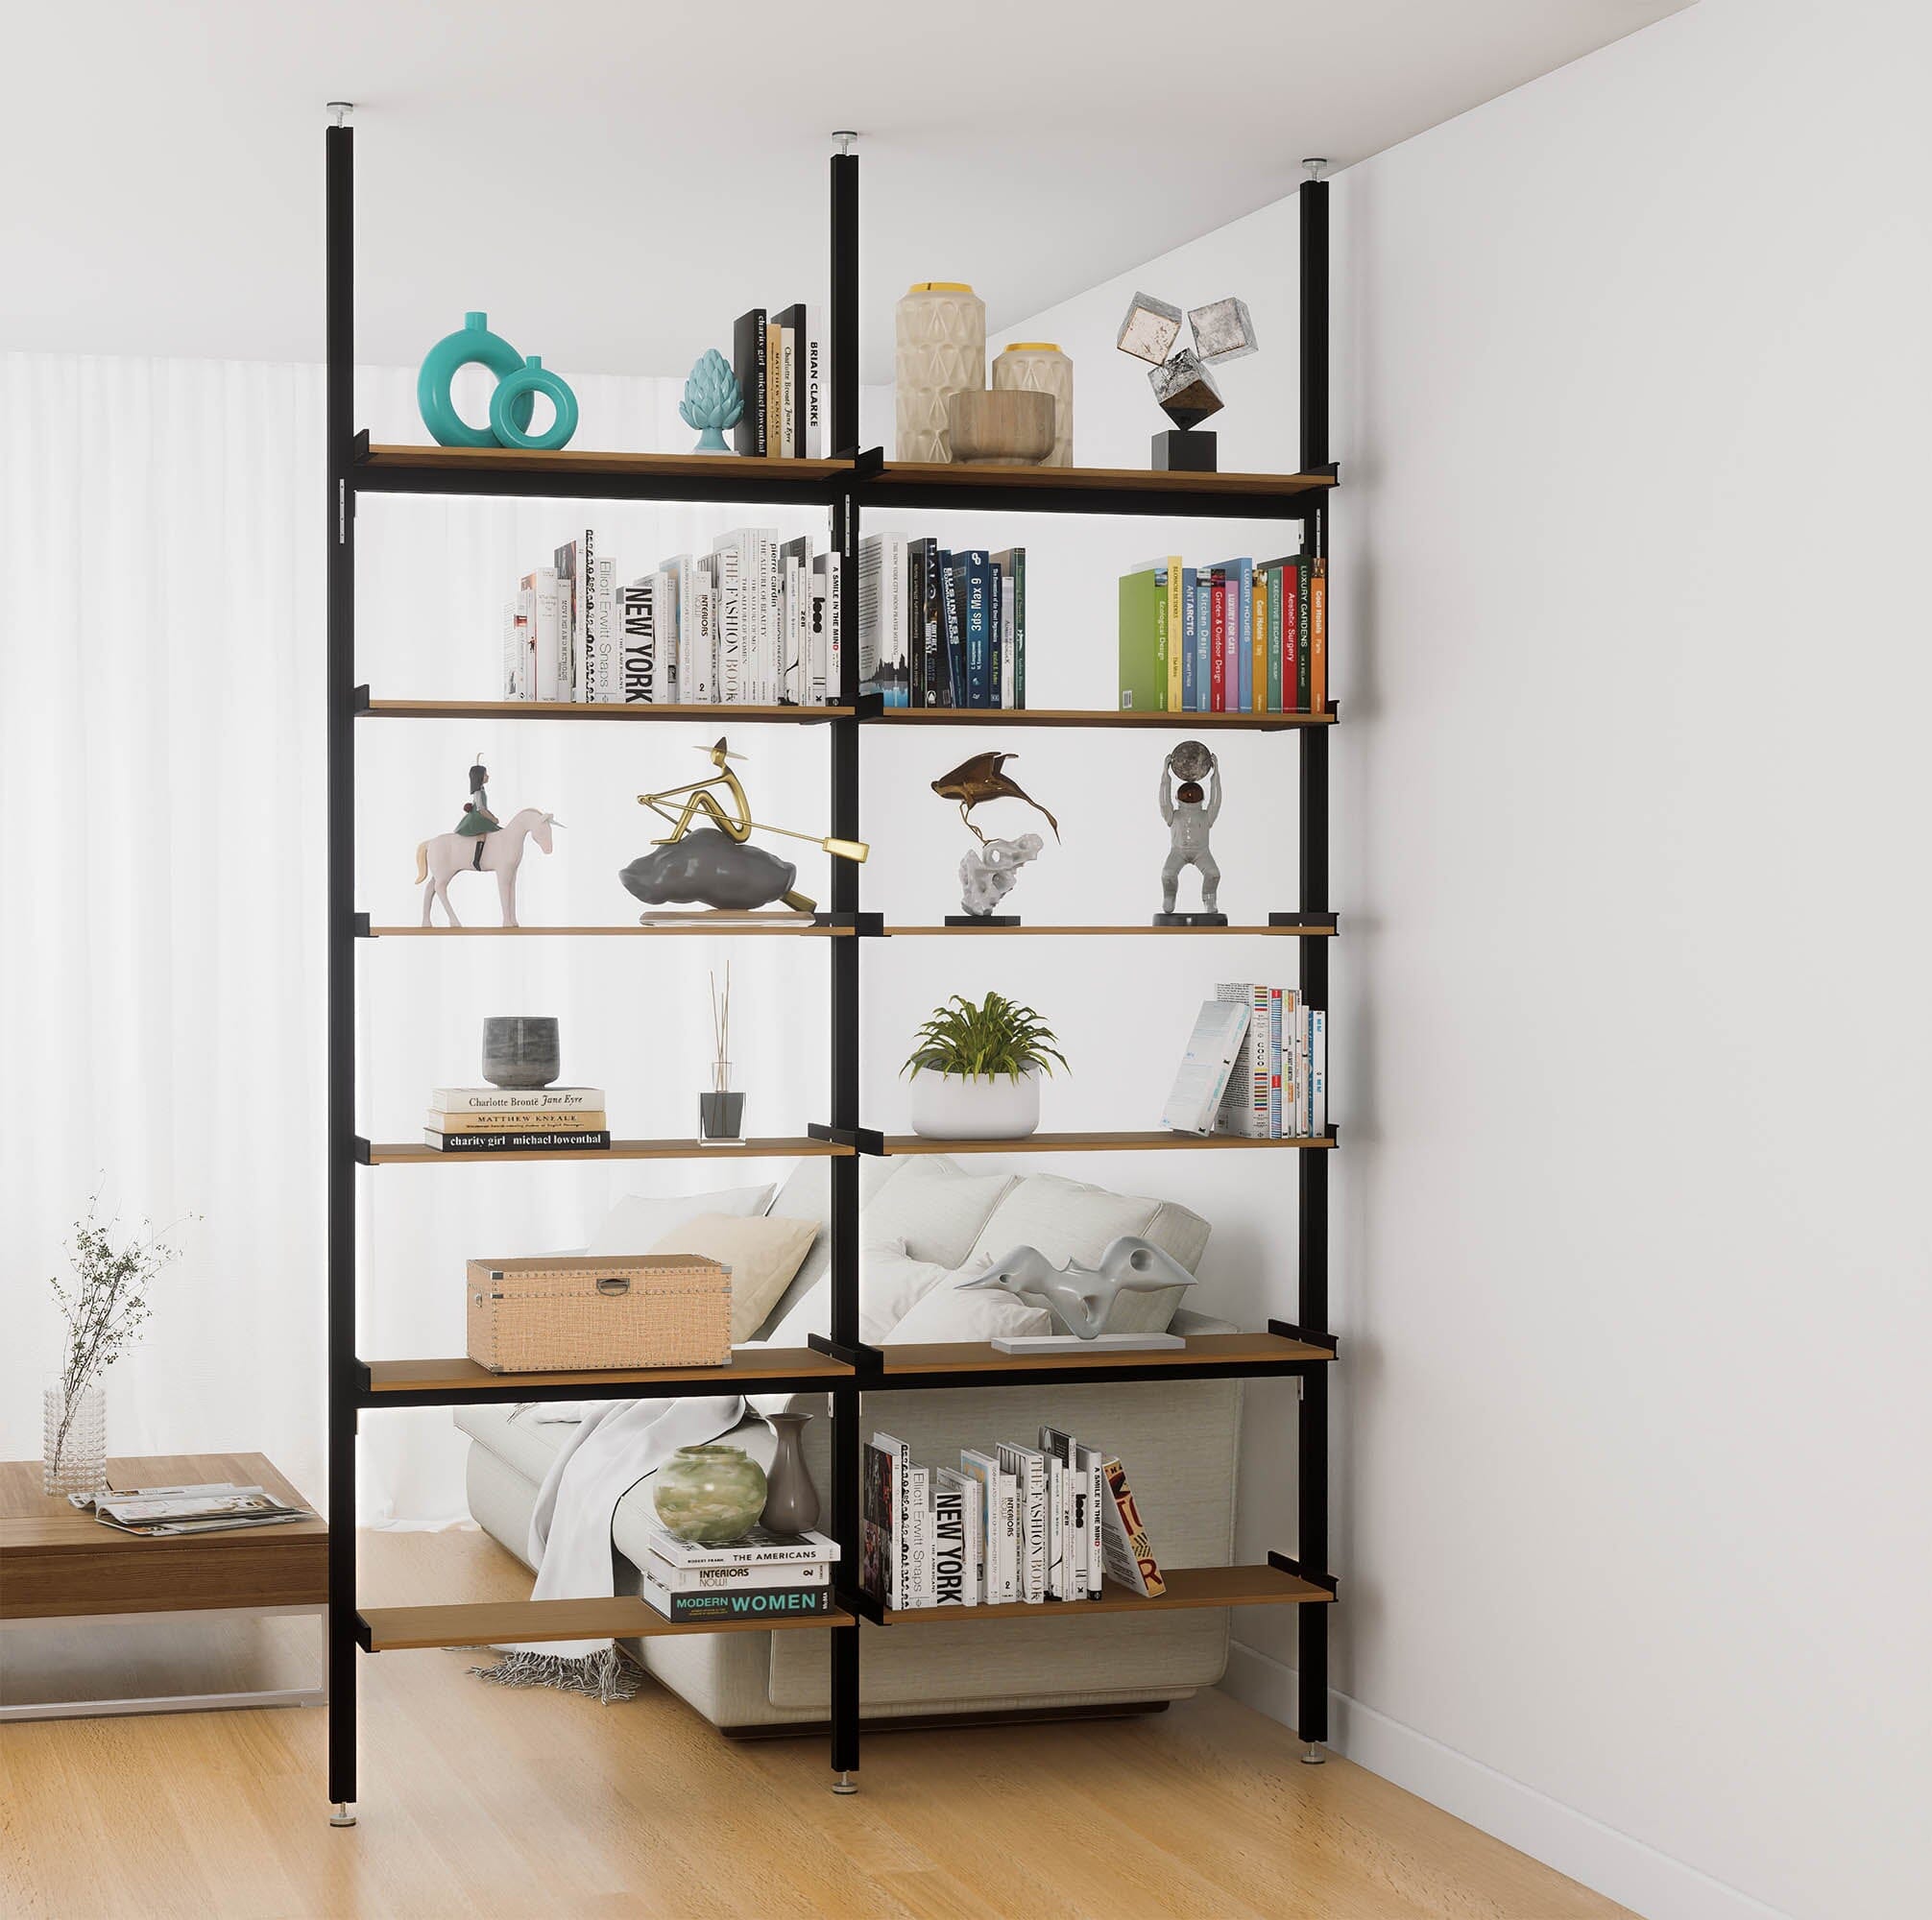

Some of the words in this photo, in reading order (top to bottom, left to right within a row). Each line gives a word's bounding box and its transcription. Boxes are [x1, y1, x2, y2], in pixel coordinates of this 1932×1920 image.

[758, 315, 766, 349] charity
[758, 349, 766, 366] girl
[758, 372, 766, 407] michael
[758, 409, 766, 453] lowenthal
[726, 552, 738, 584] THE
[769, 543, 778, 572] pierre
[600, 562, 612, 595] Elliott
[625, 588, 653, 637] NEW
[832, 602, 839, 611] IN
[946, 567, 959, 645] BUSINESS
[971, 588, 981, 609] Max
[600, 601, 612, 637] Erwitt
[726, 588, 738, 654] FASHION
[971, 612, 981, 632] 3ds
[1199, 630, 1208, 660] Design
[1287, 629, 1295, 662] Surgery
[597, 643, 612, 688] Snaps
[625, 643, 653, 703] YORK
[726, 660, 738, 702] BOOK
[1214, 660, 1222, 684] Design
[469, 1097, 508, 1107] Charlotte
[511, 1097, 538, 1106] Brontë
[542, 1095, 562, 1106] Jane
[565, 1094, 584, 1104] Eyre
[450, 1137, 485, 1148] charity
[488, 1135, 505, 1146] girl
[513, 1135, 551, 1145] michael
[553, 1134, 601, 1144] lowenthal
[913, 1473, 924, 1505] Elliott
[1030, 1457, 1043, 1490] THE
[937, 1494, 962, 1540] NEW
[1095, 1500, 1100, 1508] IN
[913, 1511, 924, 1545] Erwitt
[1030, 1492, 1043, 1555] FASHION
[756, 1551, 816, 1561] AMERICANS
[910, 1550, 924, 1592] Snaps
[699, 1569, 749, 1578] INTERIORS
[937, 1546, 962, 1604] YORK
[1030, 1558, 1043, 1601] BOOK
[676, 1596, 728, 1609] MODERN
[732, 1594, 816, 1613] WOMEN
